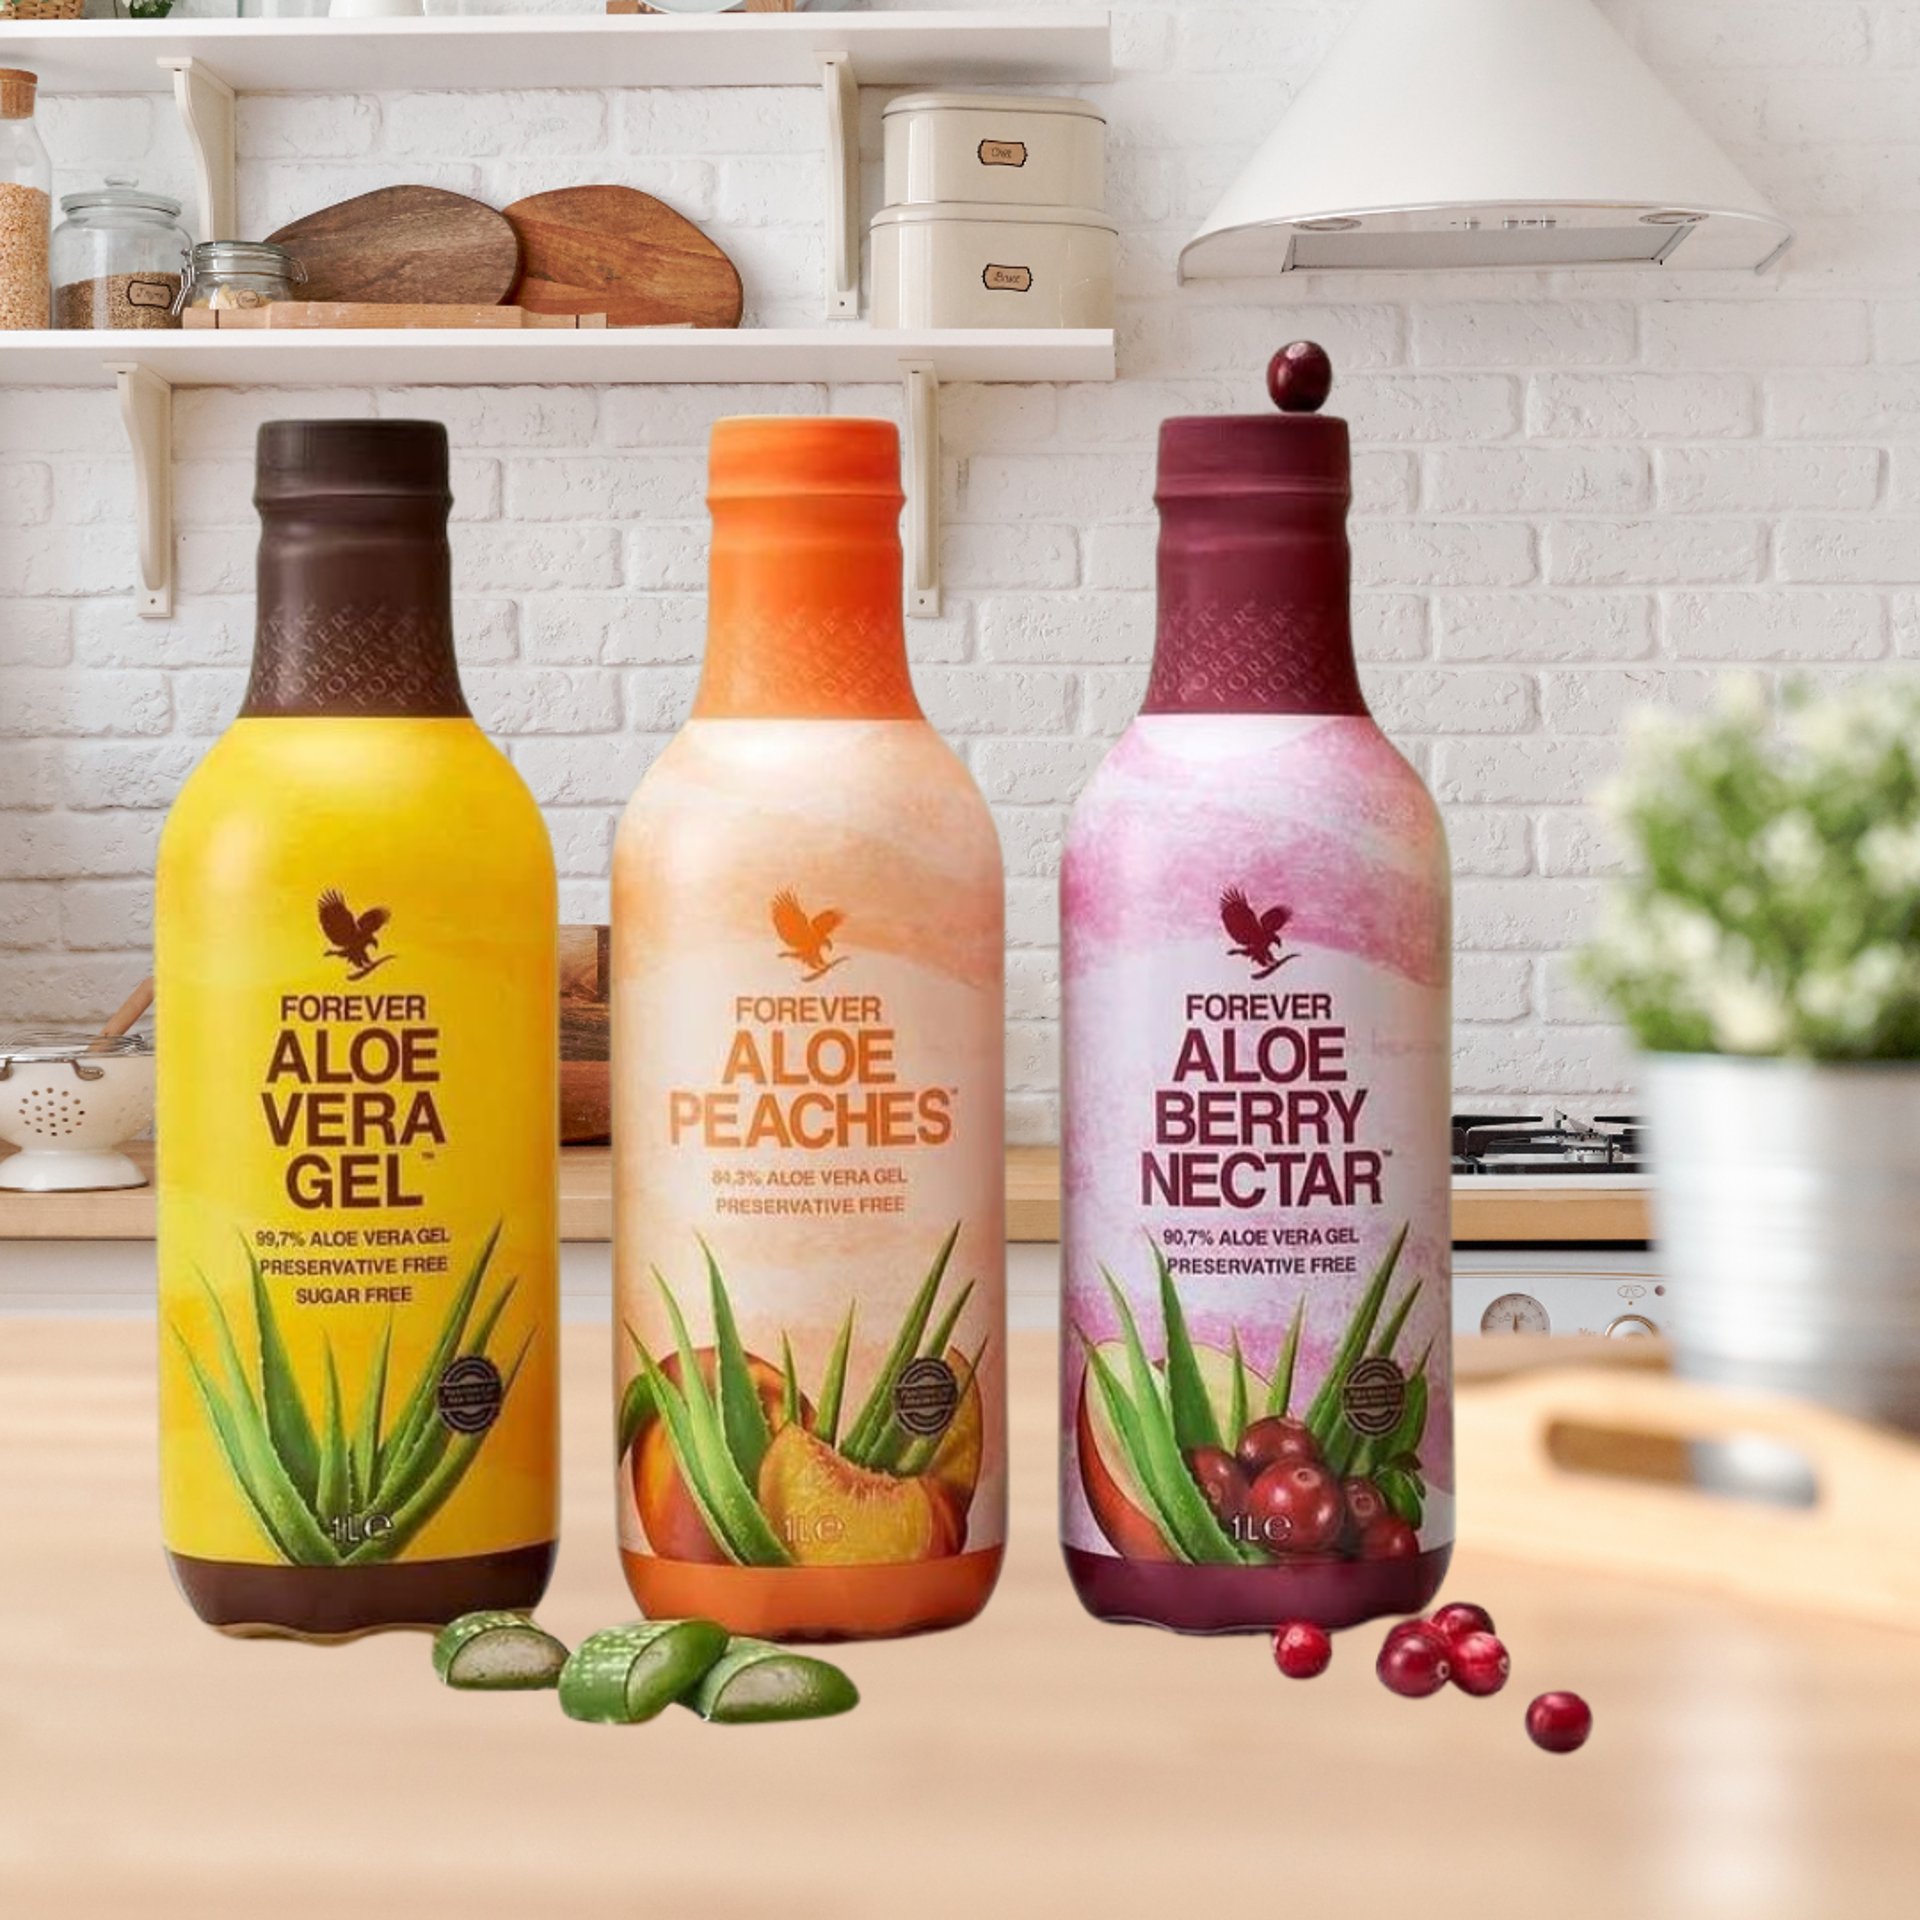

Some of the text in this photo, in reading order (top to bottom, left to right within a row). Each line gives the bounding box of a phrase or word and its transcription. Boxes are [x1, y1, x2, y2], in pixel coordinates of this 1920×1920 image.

[281, 995, 426, 1021] FOREVER
[736, 995, 881, 1023] FOREVER
[1186, 994, 1332, 1021] FOREVER
[266, 1027, 440, 1084] ALOE
[722, 1029, 896, 1086] ALOE
[1172, 1026, 1348, 1083] ALOE
[261, 1091, 446, 1146] VERA
[1156, 1089, 1368, 1146] BERRY
[767, 1170, 816, 1187] ALOE
[820, 1169, 870, 1186] VERA
[874, 1167, 908, 1184] GEL
[716, 1196, 904, 1216] PRESERVATIVE FREE
[311, 1231, 358, 1247] ALOE
[363, 1230, 414, 1246] VERA
[416, 1227, 450, 1244] GEL
[1219, 1229, 1268, 1246] ALOE
[1272, 1229, 1322, 1246] VERA
[1325, 1227, 1360, 1244] GEL
[260, 1256, 447, 1275] PRESERVATIVE FREE
[1167, 1256, 1357, 1275] PRESERVATIVE FREE
[296, 1286, 412, 1304] SUGAR FREE
